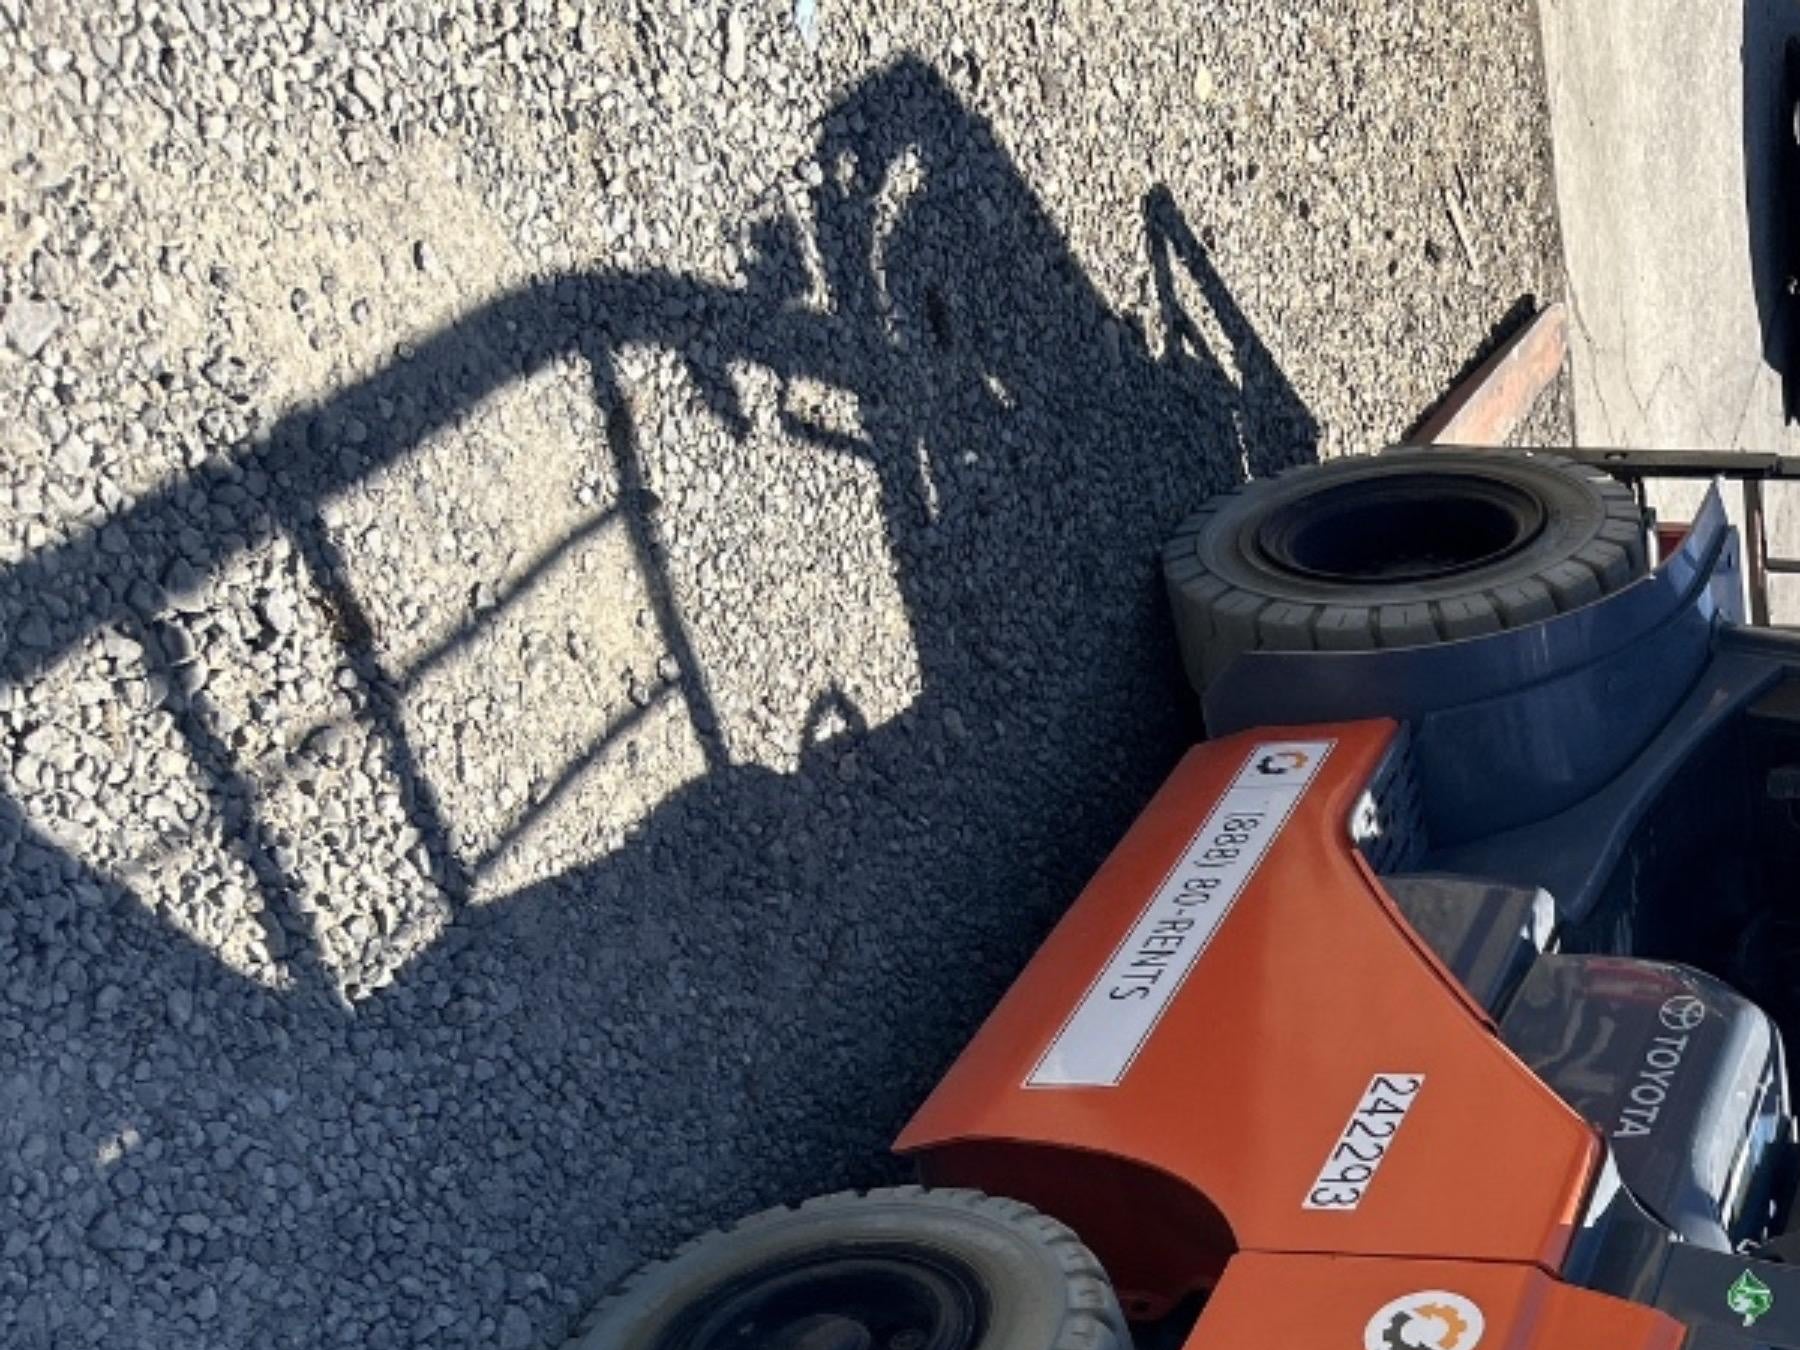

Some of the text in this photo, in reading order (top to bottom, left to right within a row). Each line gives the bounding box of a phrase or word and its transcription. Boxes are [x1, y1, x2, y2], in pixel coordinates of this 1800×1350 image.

[1109, 812, 1266, 1001] (888) 80-RENTS
[1310, 1077, 1420, 1206] 242293
[1612, 1035, 1690, 1138] TOYOTA
